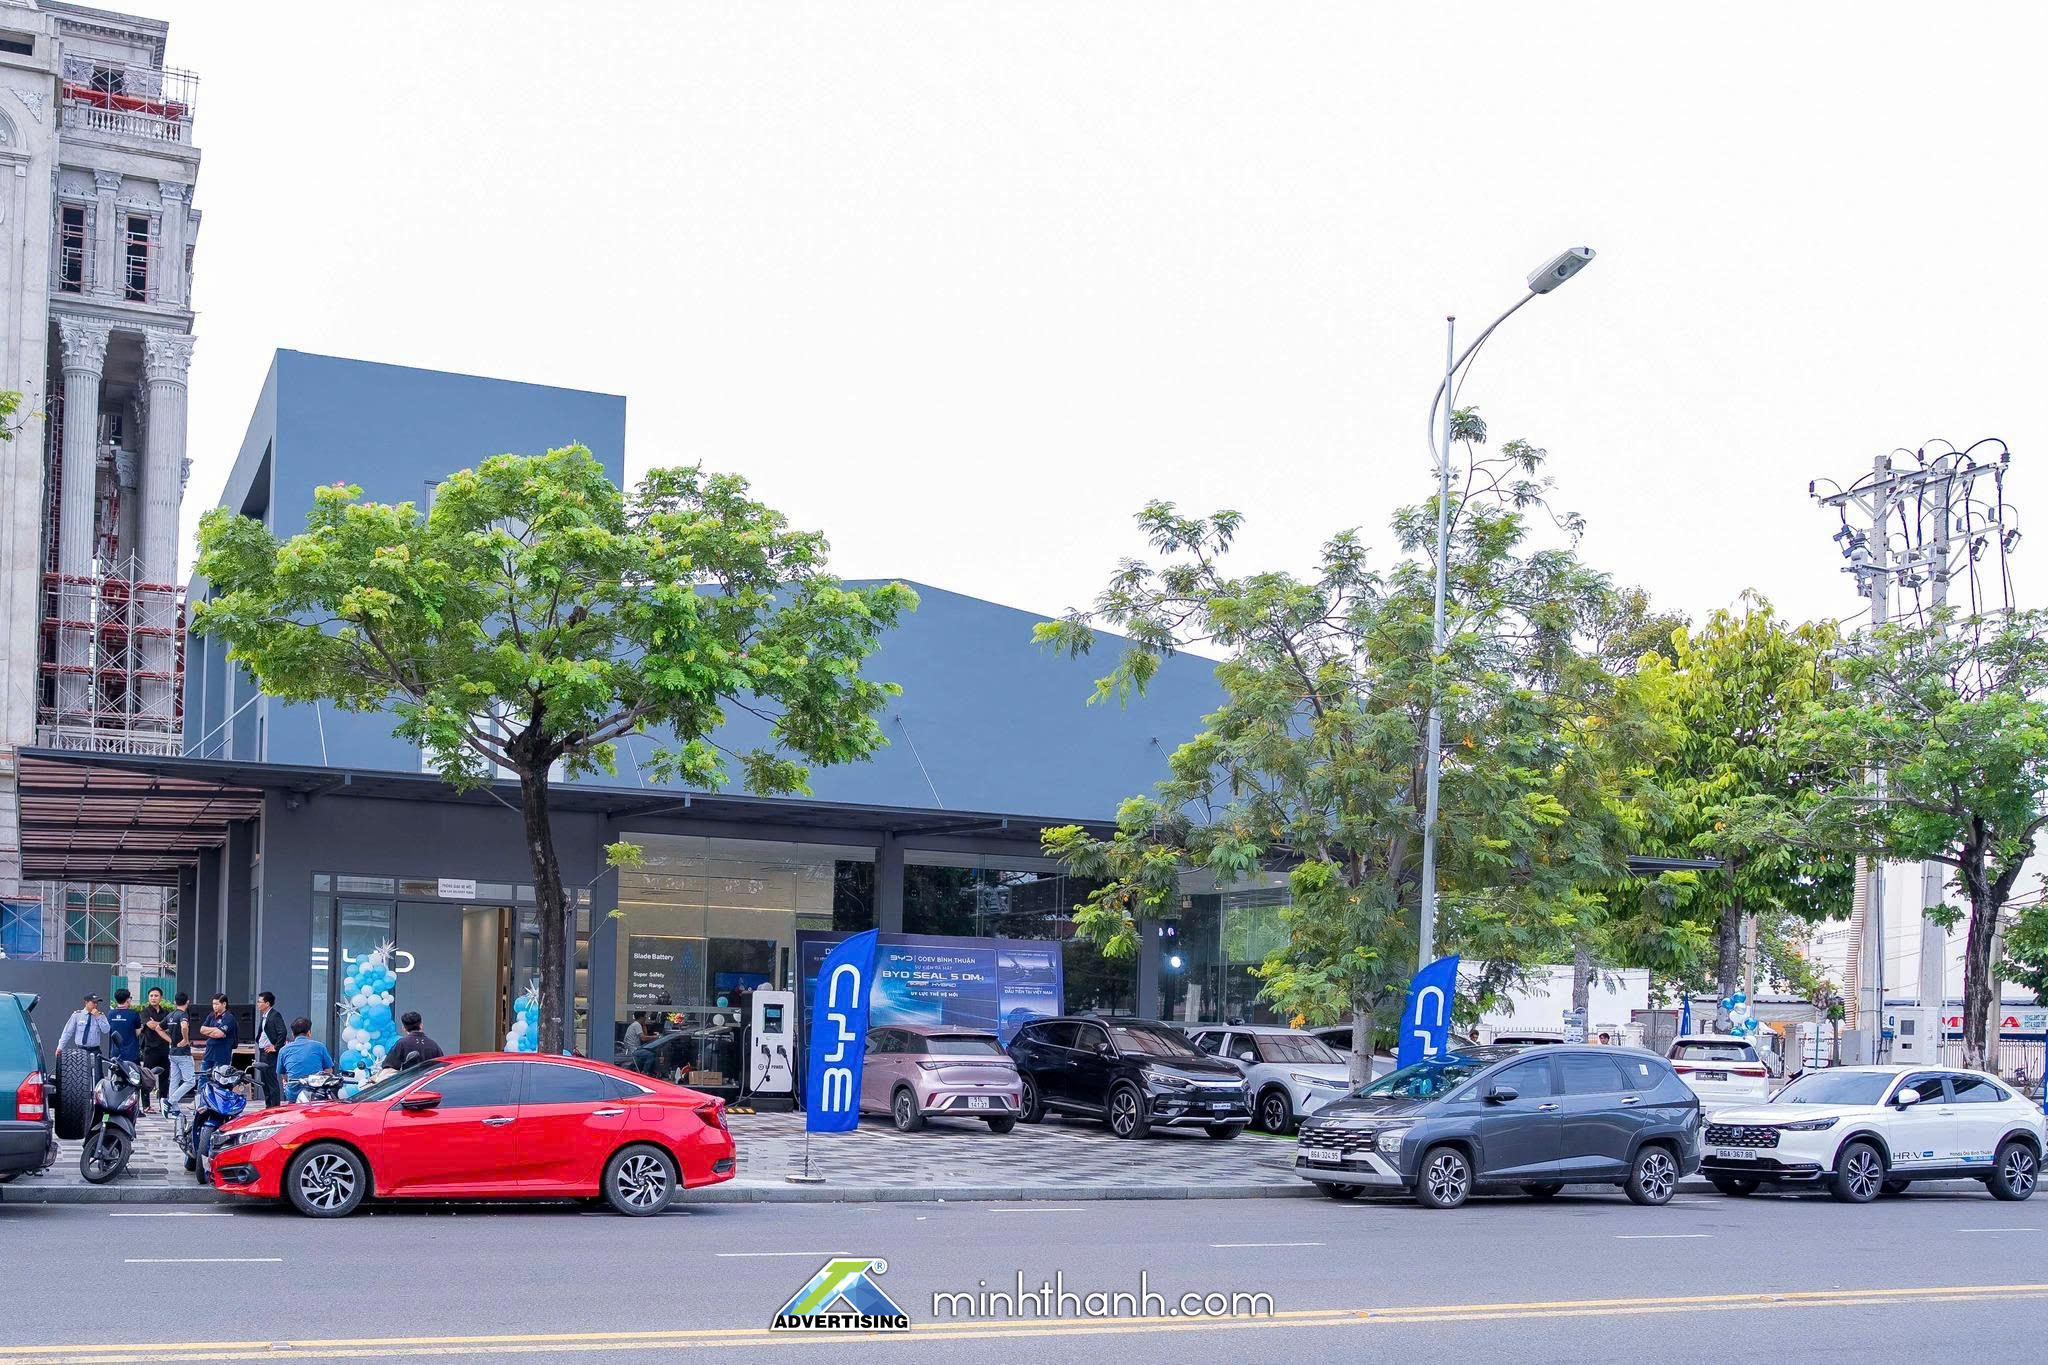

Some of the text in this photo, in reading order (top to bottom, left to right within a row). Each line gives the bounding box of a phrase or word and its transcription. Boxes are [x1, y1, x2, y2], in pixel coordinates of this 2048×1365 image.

[652, 953, 674, 961] Battery
[937, 954, 953, 964] BÌNH
[882, 970, 910, 979] BYD
[913, 971, 947, 980] SEAL
[950, 972, 959, 980] 5
[821, 963, 861, 1112] BYD
[1893, 1151, 1922, 1160] HR-V
